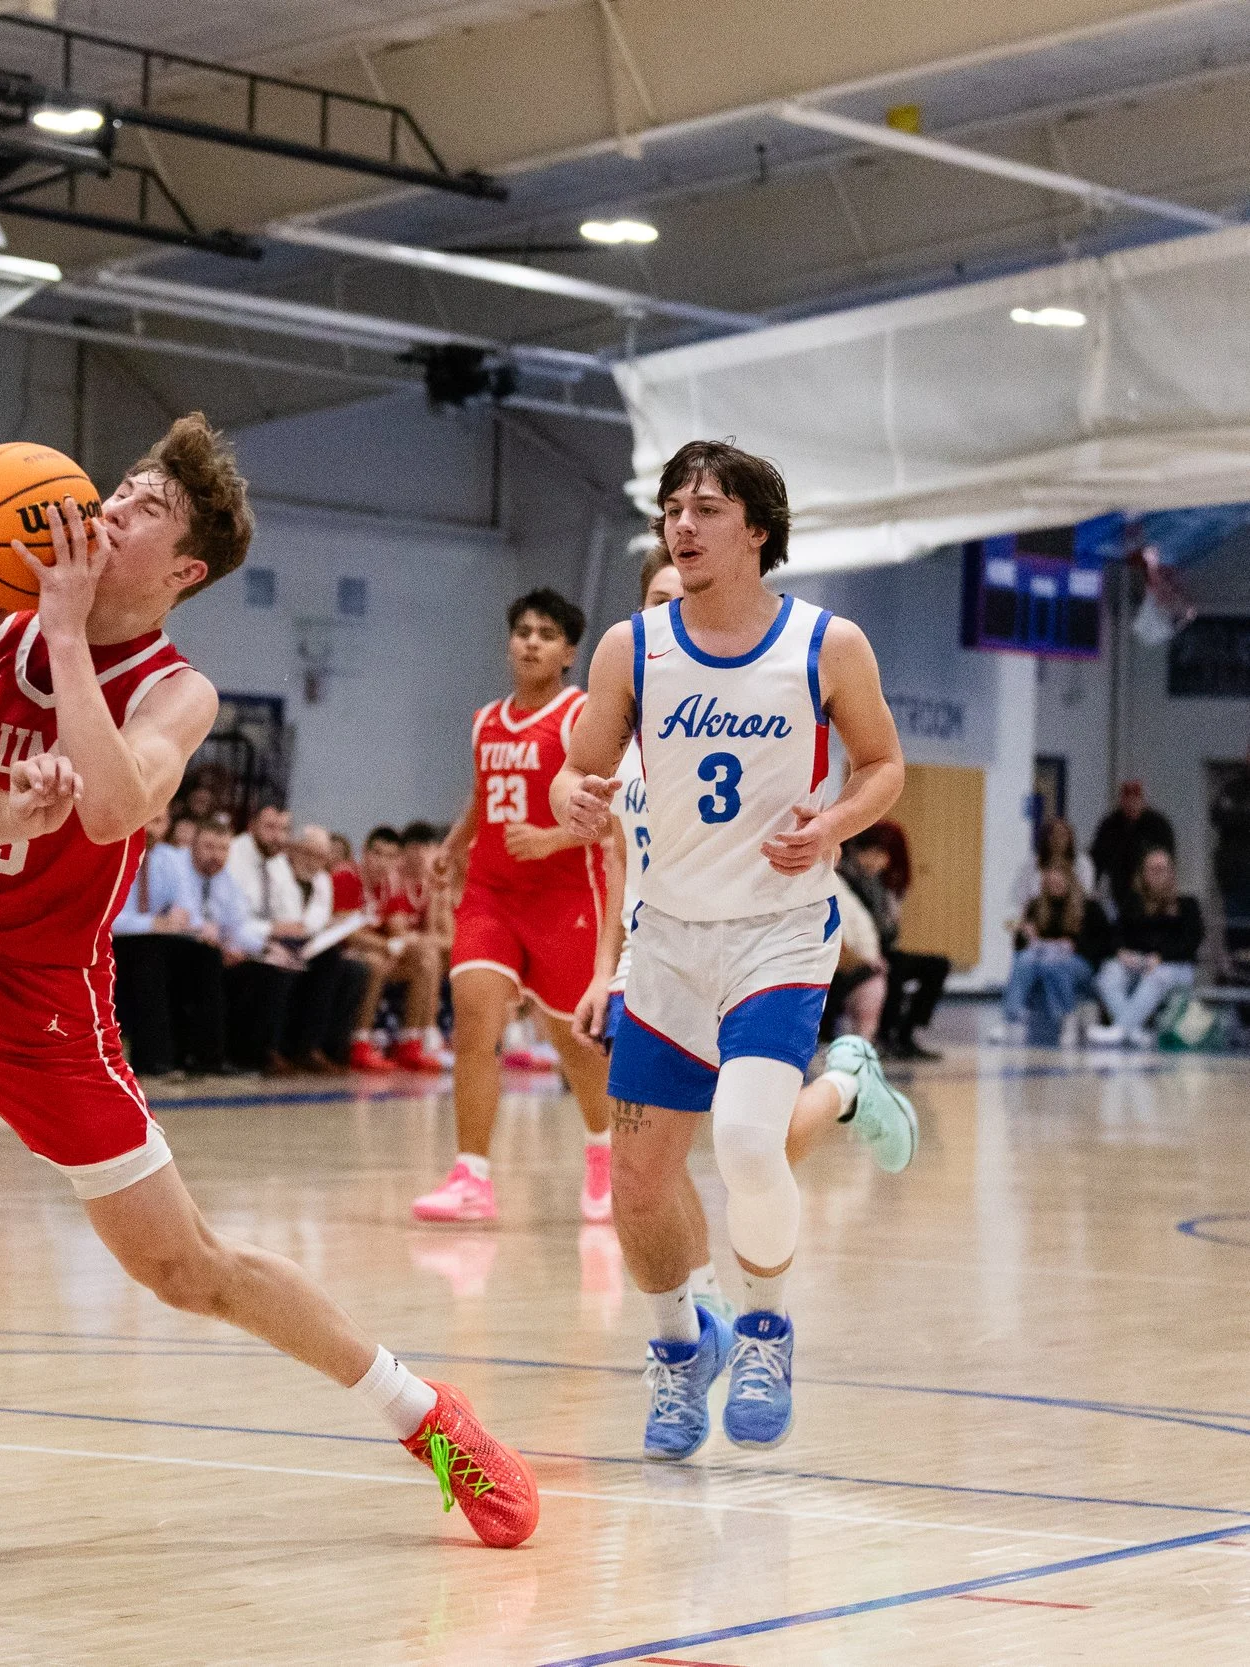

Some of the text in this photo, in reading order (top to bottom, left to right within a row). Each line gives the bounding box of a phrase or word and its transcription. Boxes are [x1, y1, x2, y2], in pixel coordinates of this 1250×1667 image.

[658, 694, 792, 739] Akron
[480, 741, 540, 772] YUMA
[486, 774, 528, 824] 23
[697, 752, 743, 824] 3
